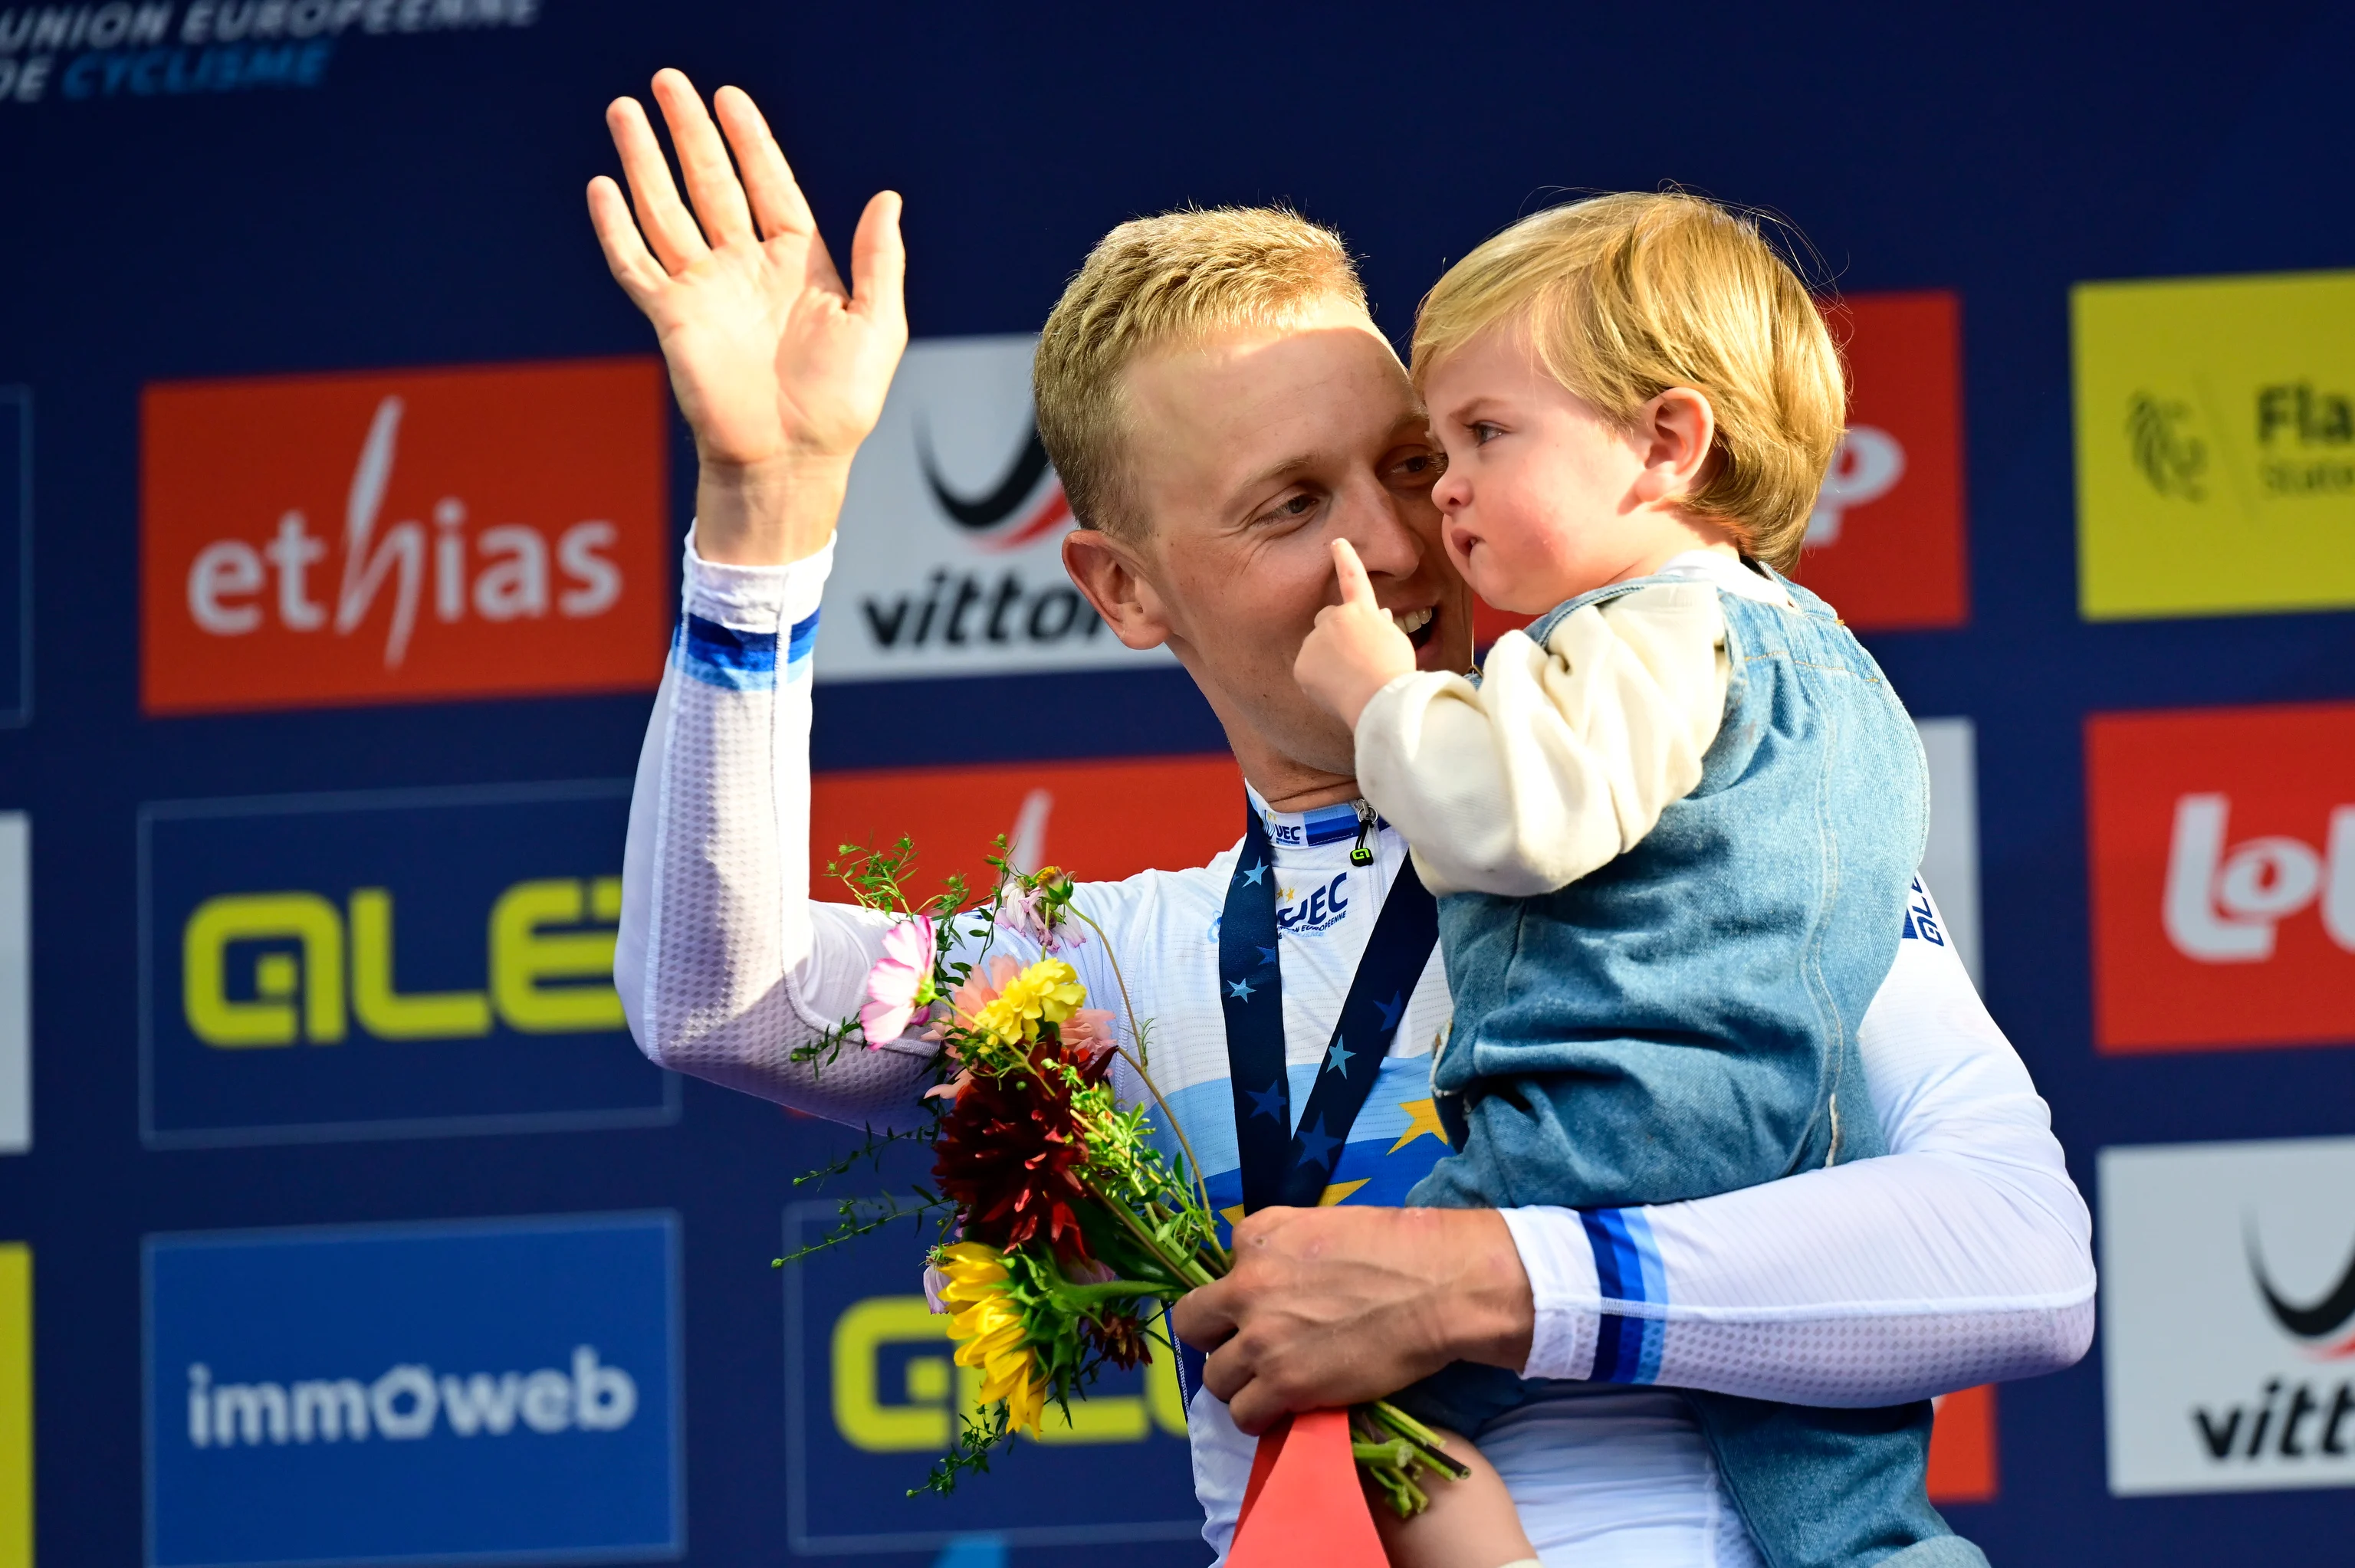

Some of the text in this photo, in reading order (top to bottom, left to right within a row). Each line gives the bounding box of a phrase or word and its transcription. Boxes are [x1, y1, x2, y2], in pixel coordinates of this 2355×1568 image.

[0, 2, 172, 51] UNION
[61, 43, 333, 100] CYCLISME
[187, 395, 623, 671] ethias
[1274, 823, 1301, 841] UEC
[1277, 871, 1348, 928] UEC
[187, 1343, 639, 1448] immoweb
